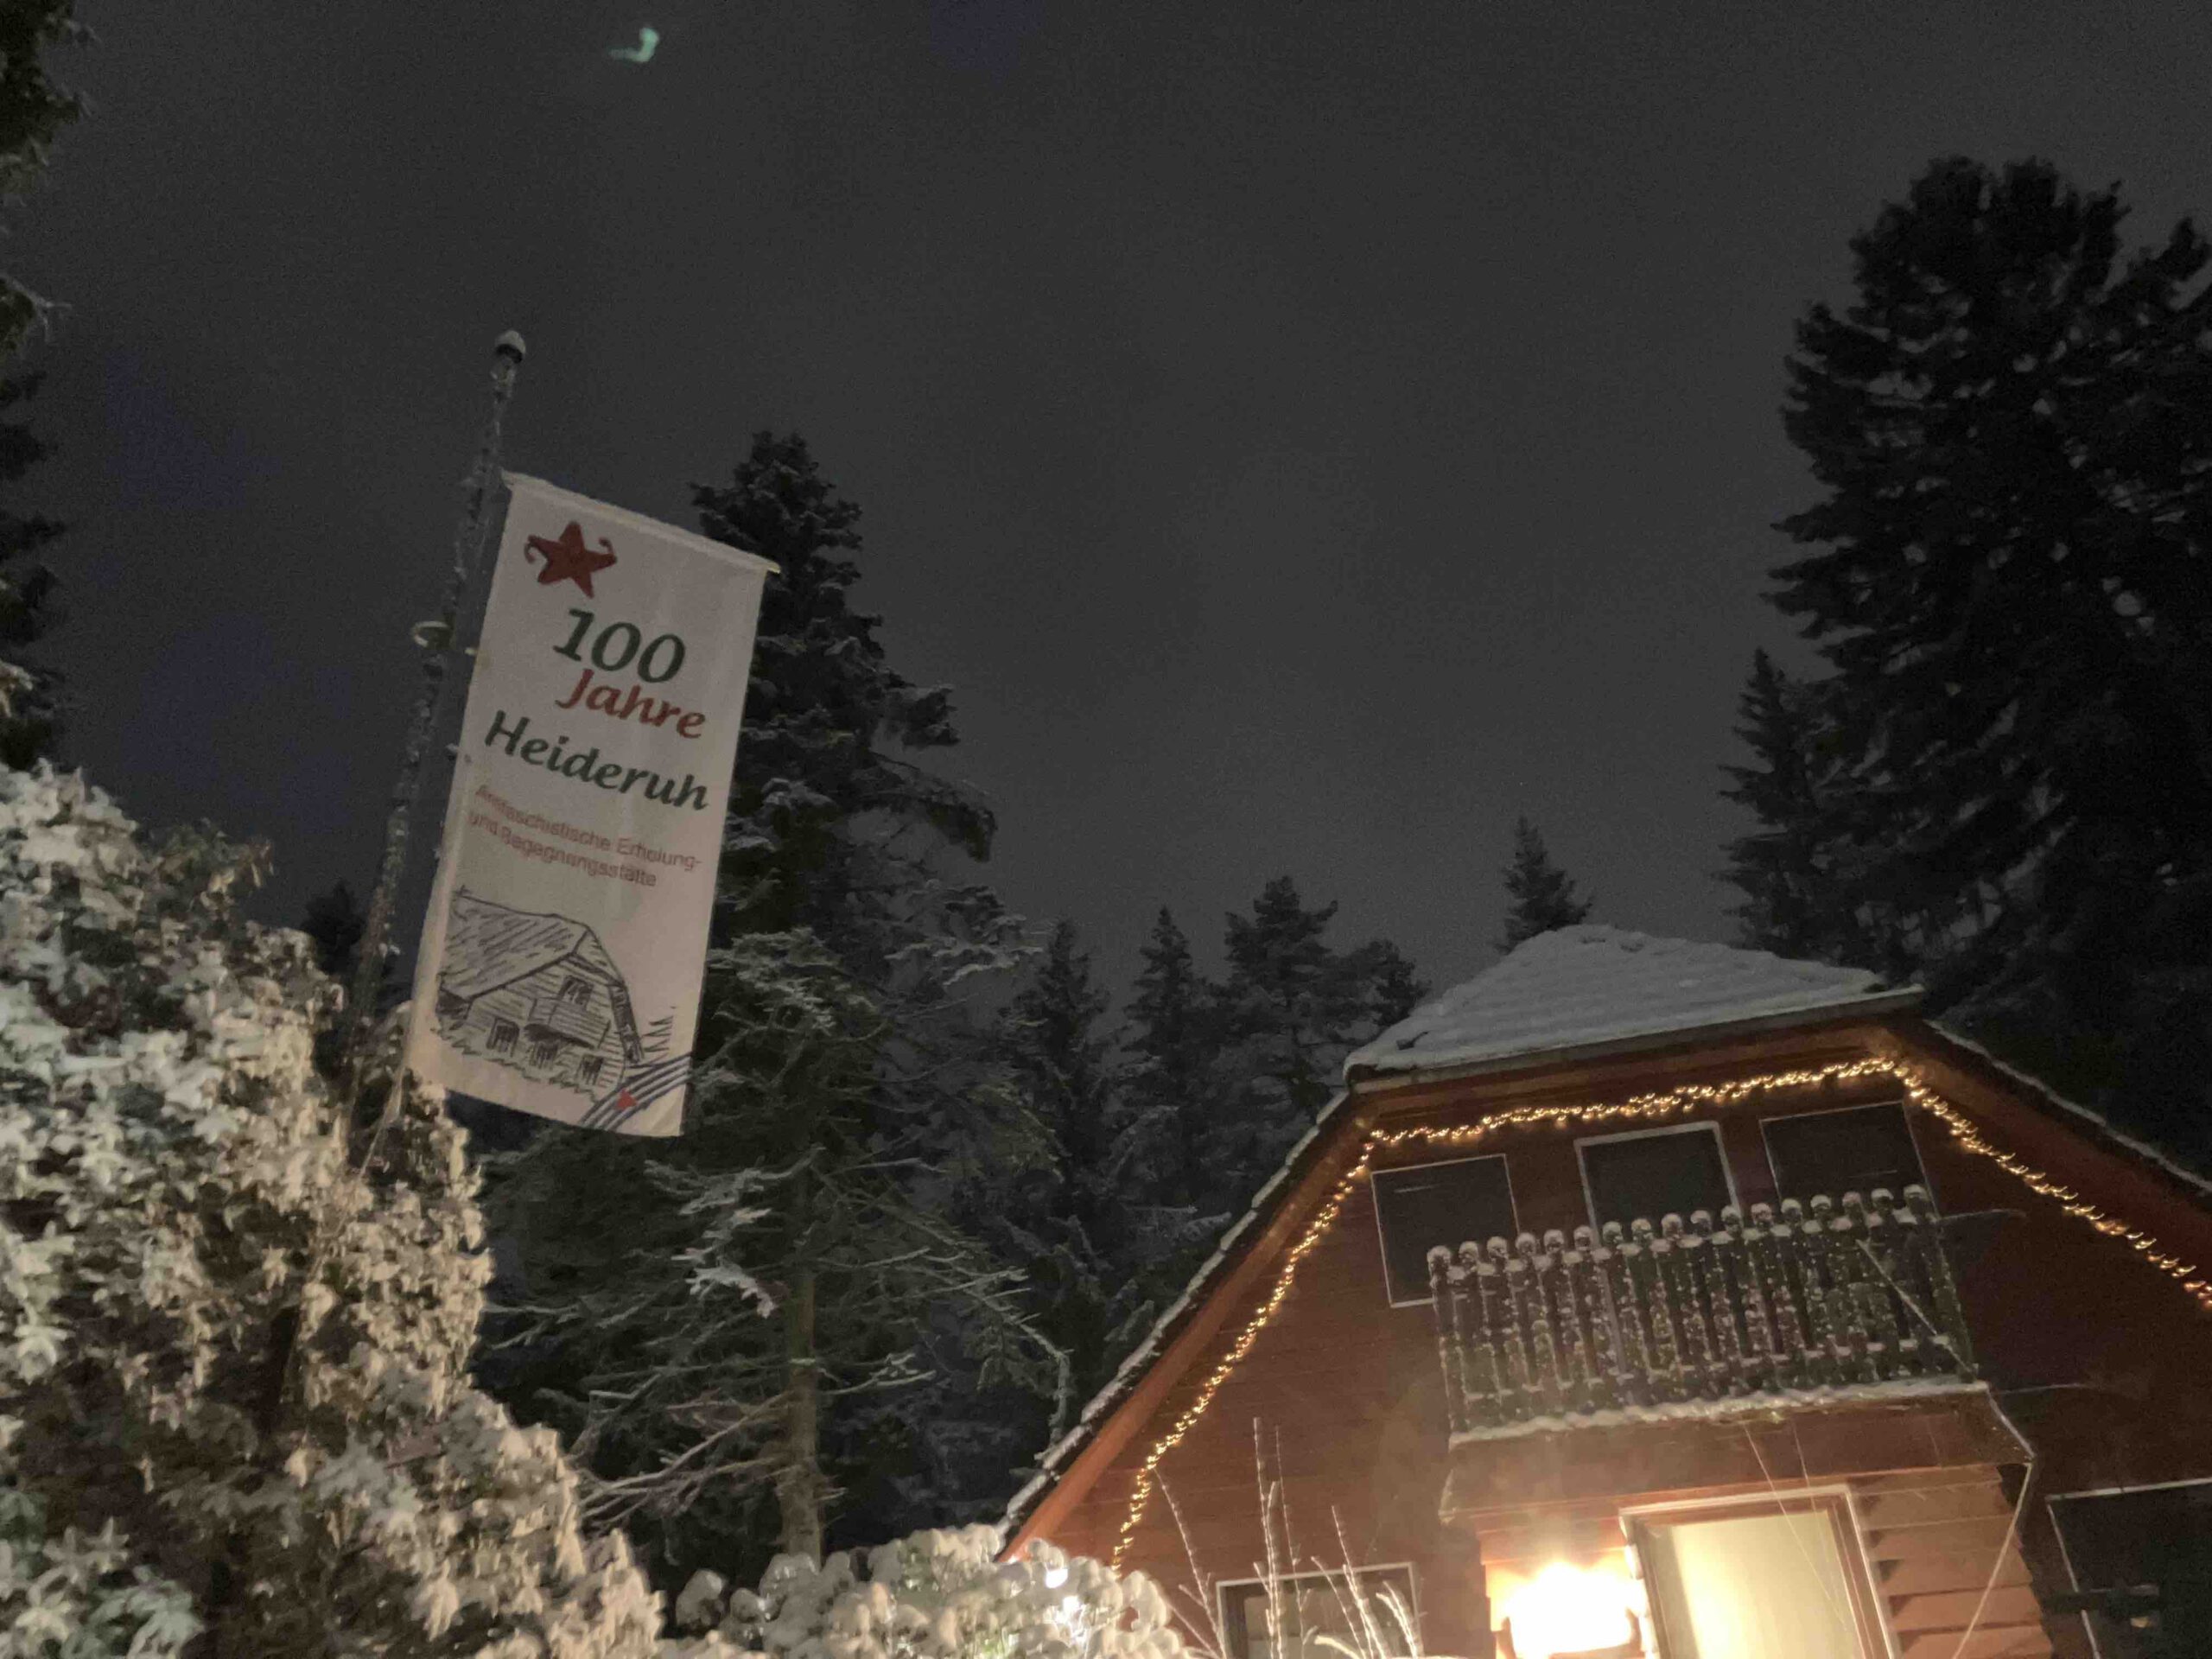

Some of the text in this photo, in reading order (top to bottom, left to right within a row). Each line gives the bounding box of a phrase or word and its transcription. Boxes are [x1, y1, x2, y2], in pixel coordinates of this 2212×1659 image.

[553, 608, 686, 683] 100
[555, 668, 706, 739] Jahre
[485, 709, 709, 810] Heideruh
[468, 810, 498, 836] und
